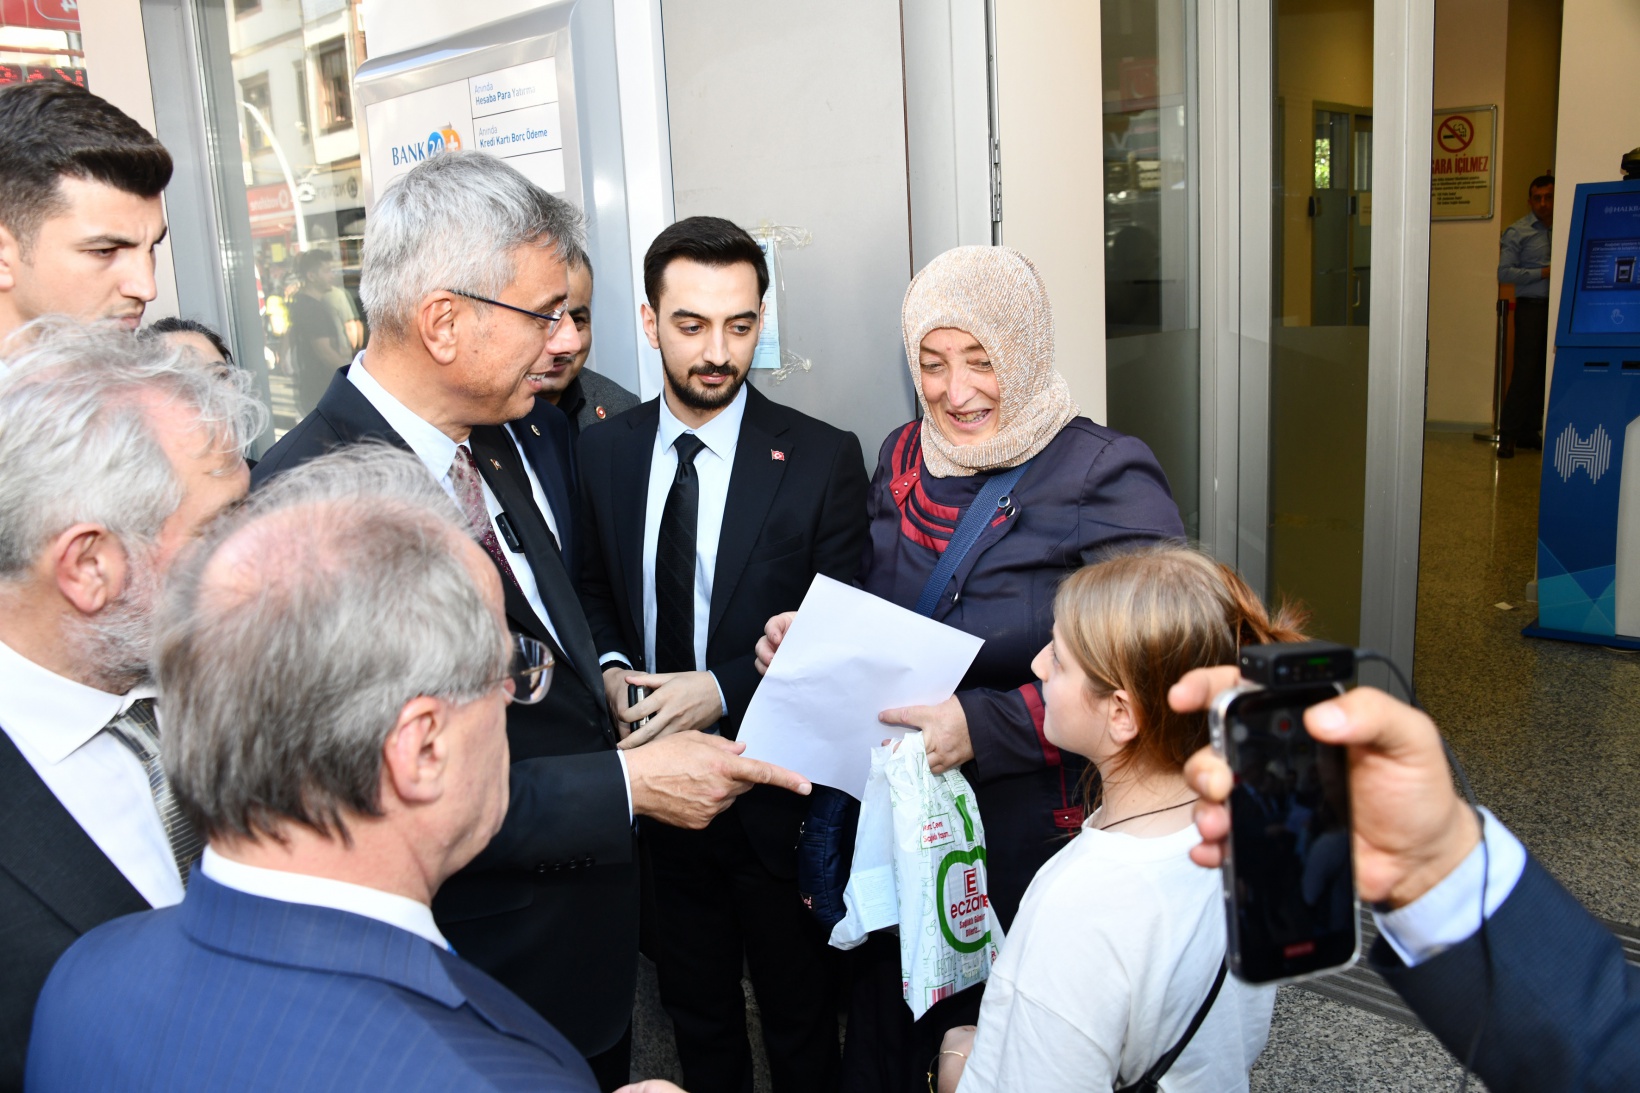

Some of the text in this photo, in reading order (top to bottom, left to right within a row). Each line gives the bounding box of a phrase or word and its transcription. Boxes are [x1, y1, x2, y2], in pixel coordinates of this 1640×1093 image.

[475, 86, 535, 105] Hesaba Para Yatırma
[480, 138, 495, 148] Kredi
[496, 135, 510, 145] Kartı
[526, 128, 548, 140] Ödeme
[392, 141, 426, 165] BANK
[1455, 153, 1488, 175] İÇİLMEZ
[966, 873, 977, 893] E
